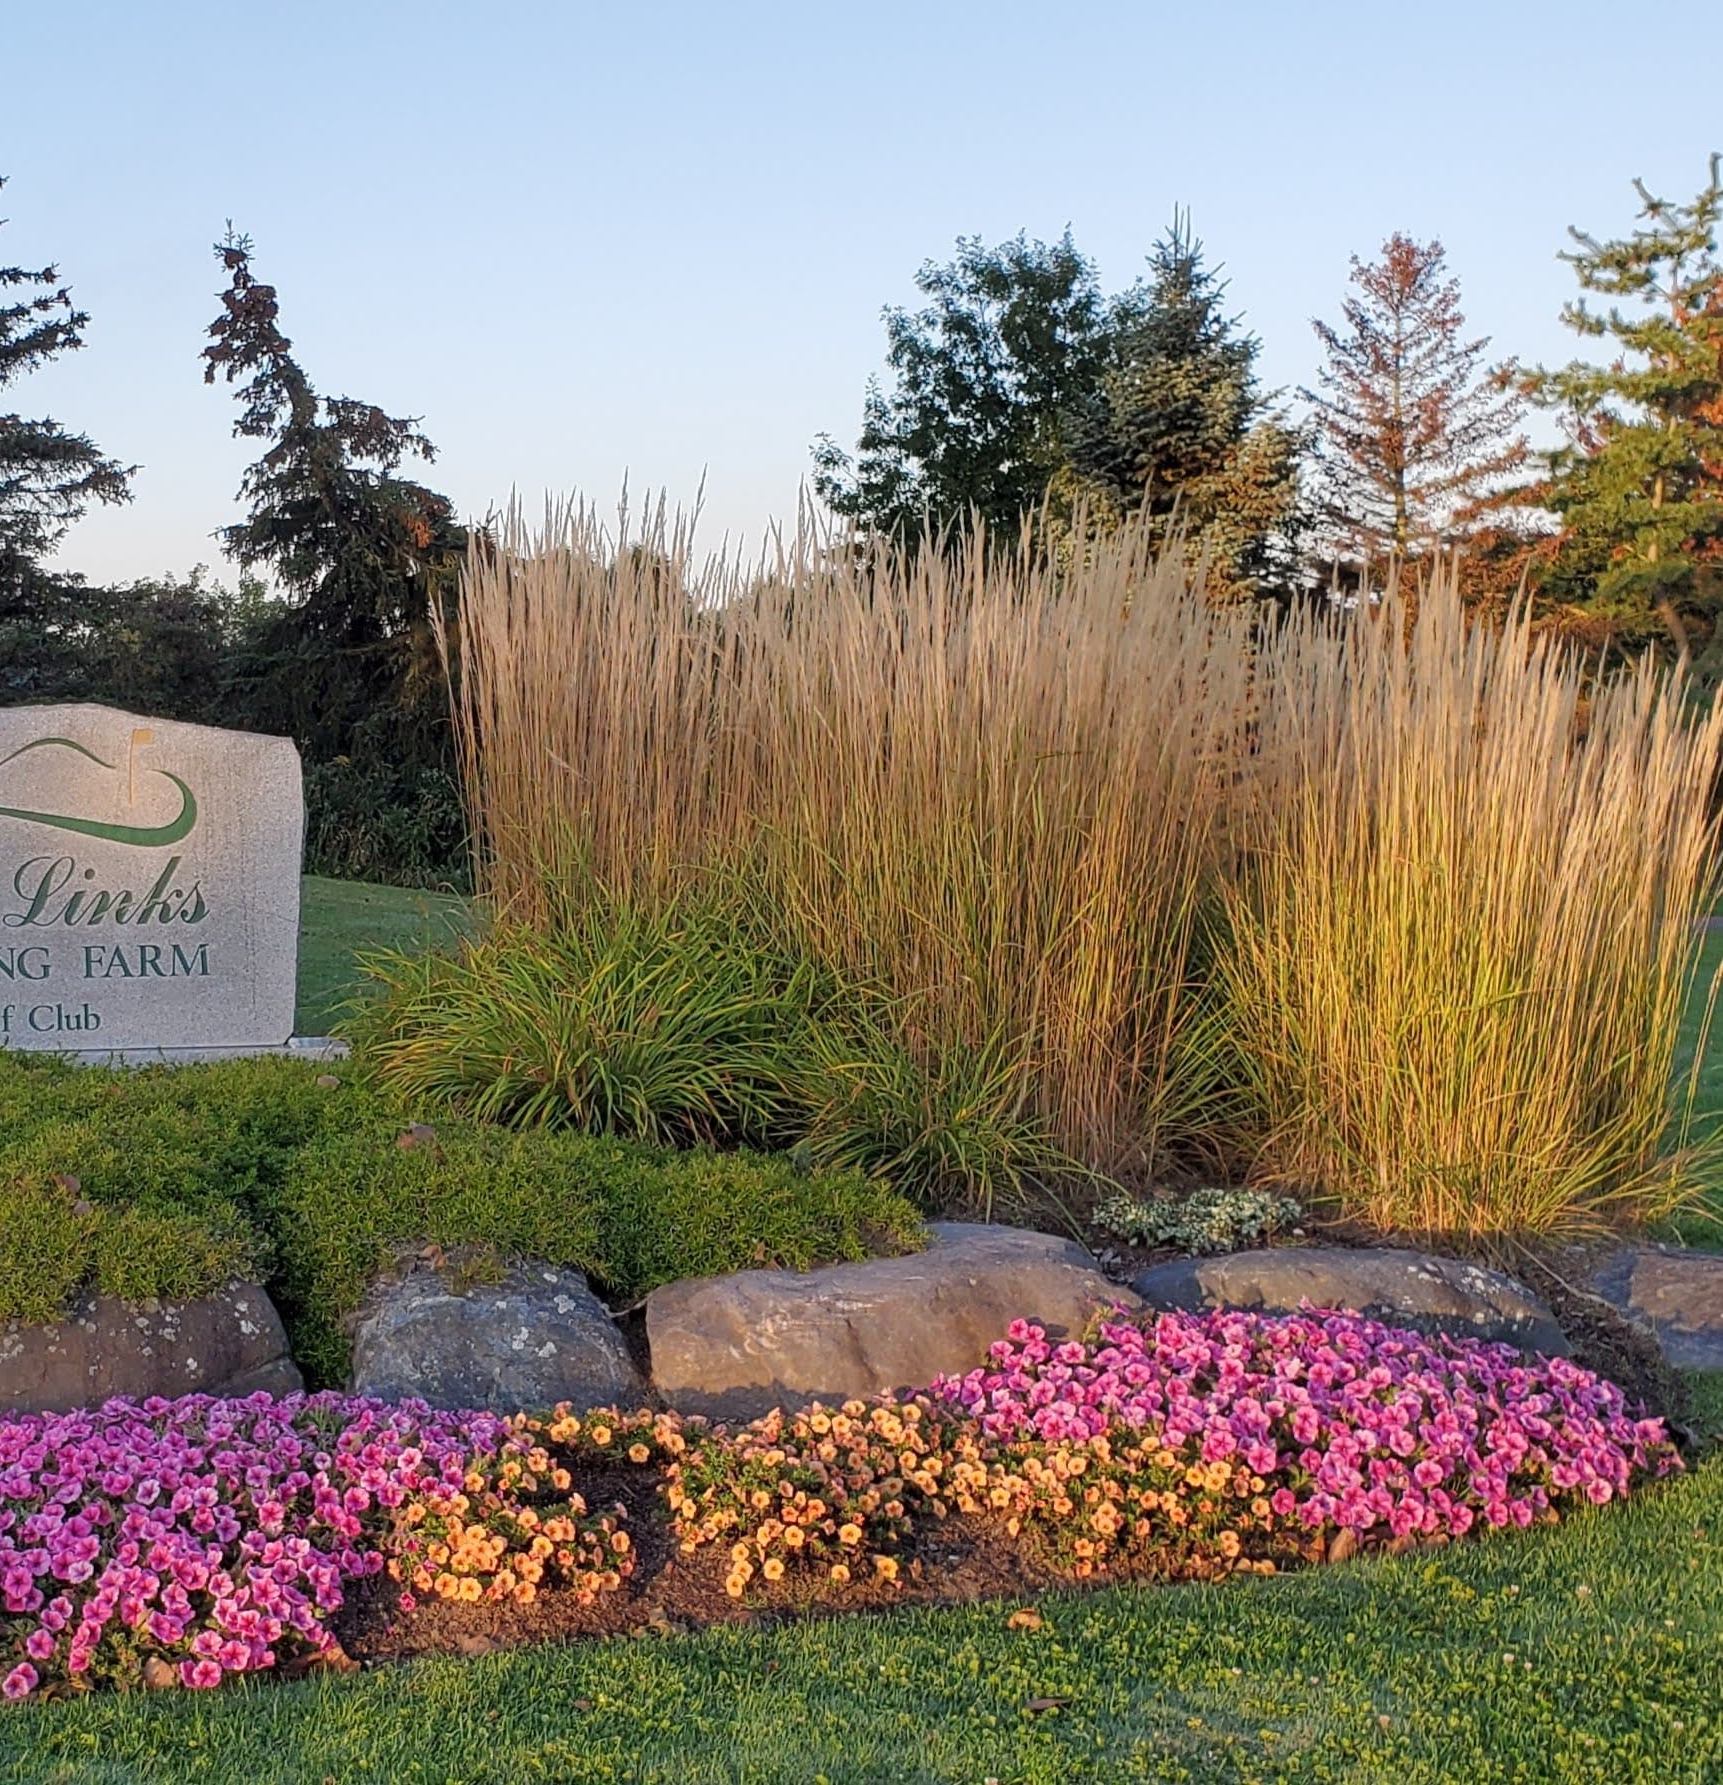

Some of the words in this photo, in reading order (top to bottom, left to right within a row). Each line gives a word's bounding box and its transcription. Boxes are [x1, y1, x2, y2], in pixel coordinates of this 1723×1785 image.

[2, 854, 211, 929] Links
[84, 943, 211, 979] FARM
[28, 1002, 102, 1033] Club
